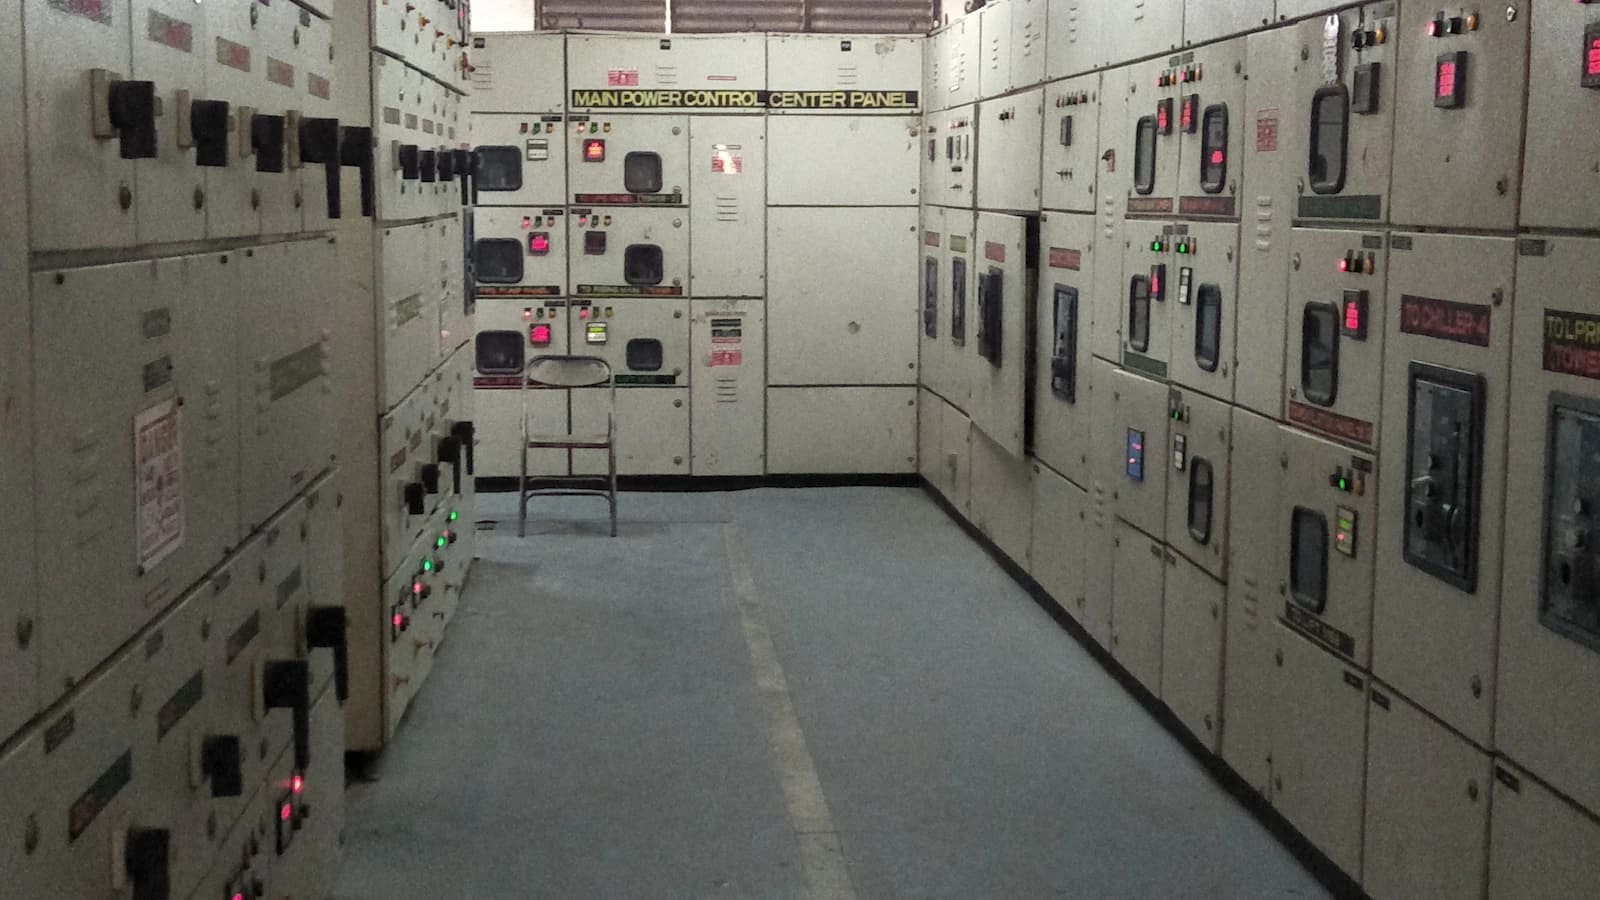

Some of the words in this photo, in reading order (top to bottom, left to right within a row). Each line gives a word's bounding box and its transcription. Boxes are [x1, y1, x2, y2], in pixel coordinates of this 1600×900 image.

[574, 91, 618, 106] MAIN
[621, 91, 681, 106] POWER
[684, 91, 765, 107] CONTROL
[769, 92, 845, 107] CENTER
[850, 92, 914, 107] PANEL
